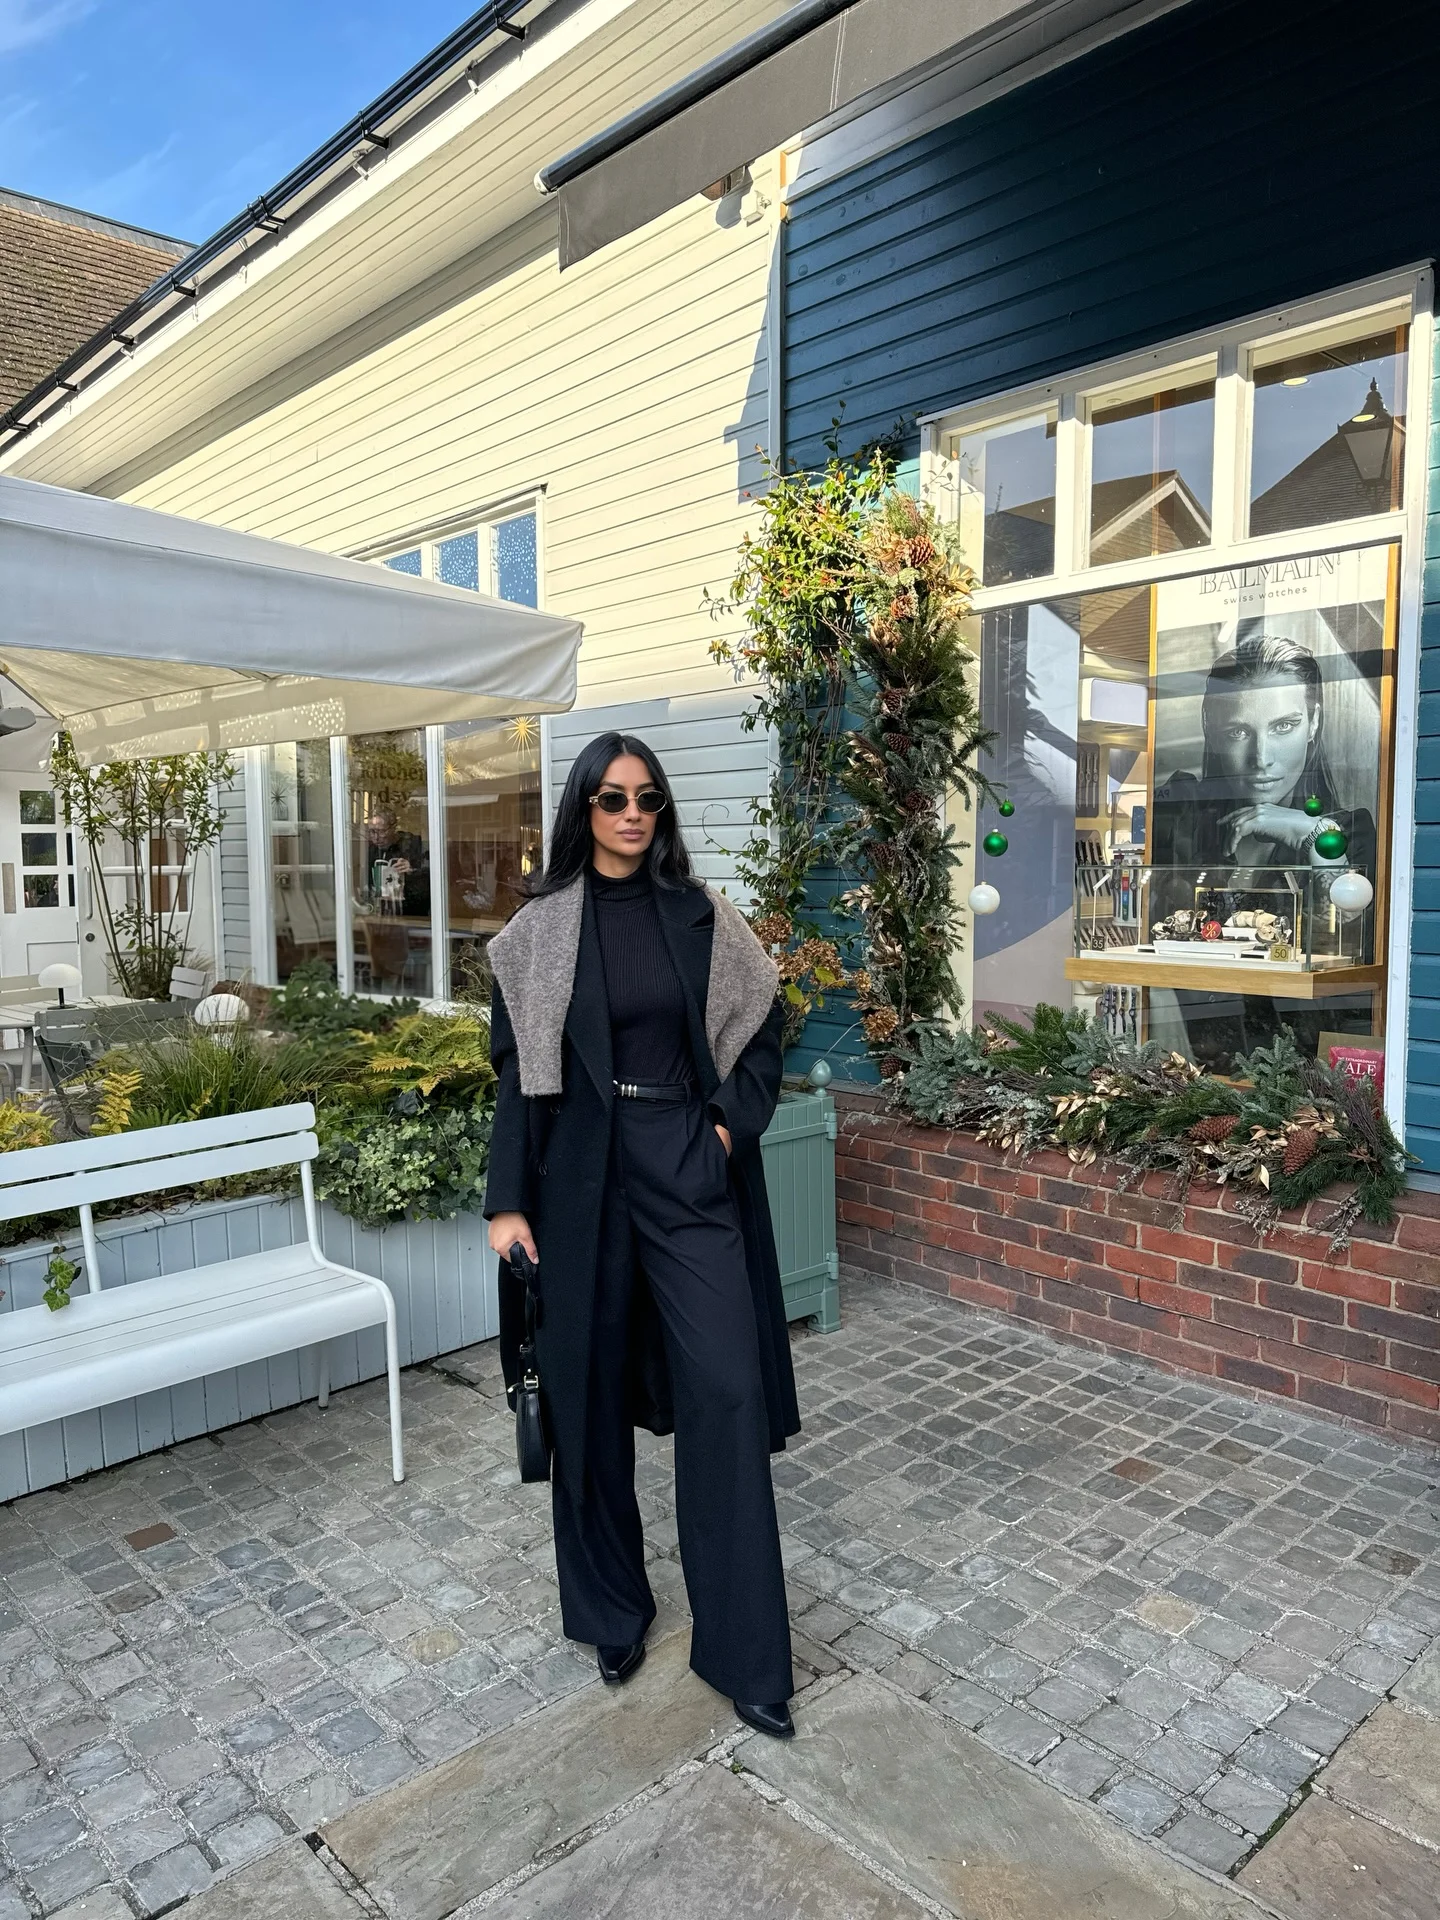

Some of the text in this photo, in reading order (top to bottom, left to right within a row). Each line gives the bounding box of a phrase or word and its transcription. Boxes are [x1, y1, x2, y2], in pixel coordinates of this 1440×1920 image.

[1198, 554, 1335, 595] BALMAIN
[1223, 585, 1308, 605] swiss watches
[1092, 939, 1104, 949] 35
[1273, 948, 1288, 959] 50
[1341, 1061, 1377, 1077] ALE
